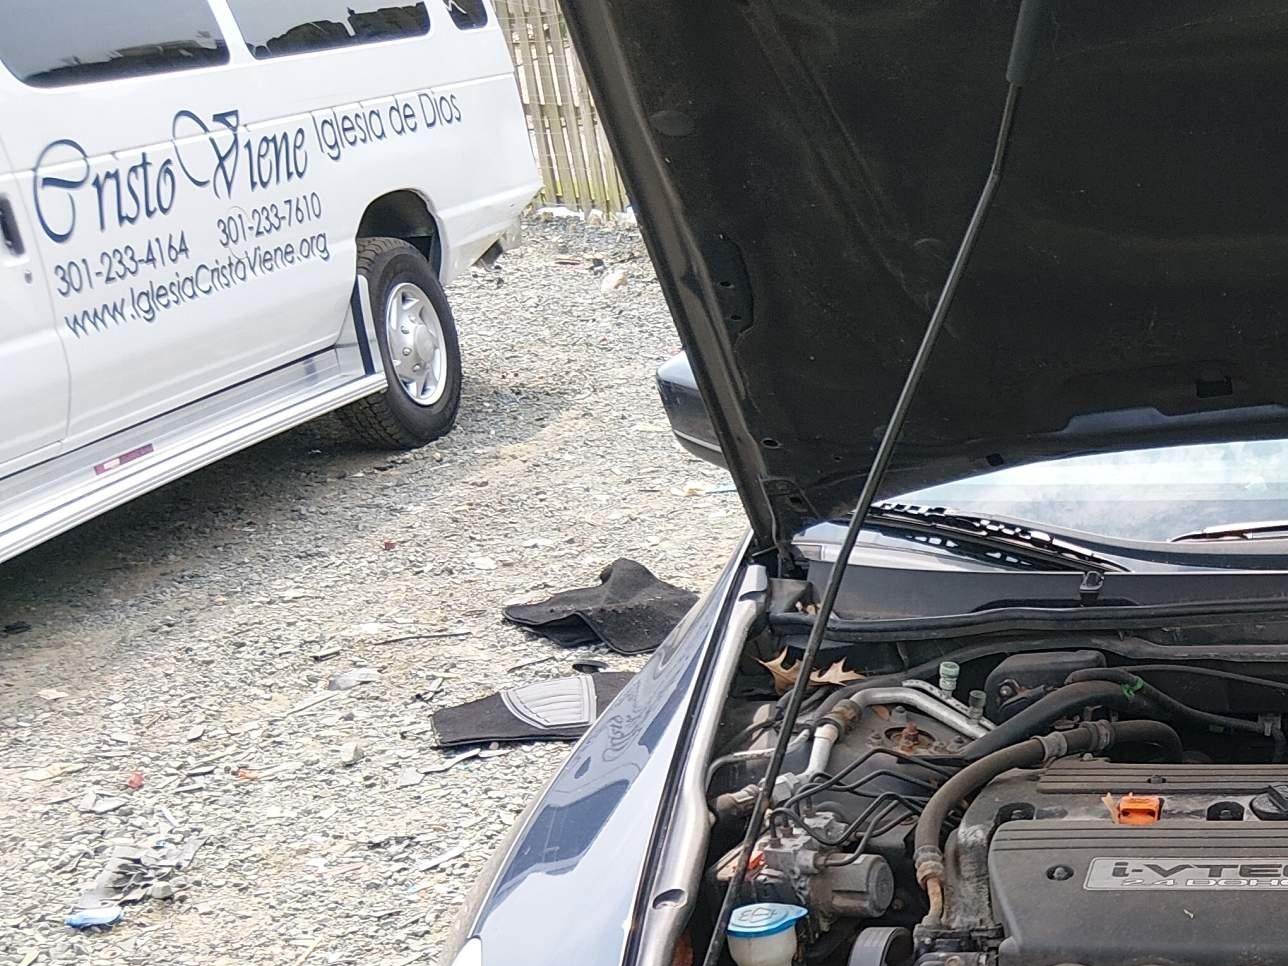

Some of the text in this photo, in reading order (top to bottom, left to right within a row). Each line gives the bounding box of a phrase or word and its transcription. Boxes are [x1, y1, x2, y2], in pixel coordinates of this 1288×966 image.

[312, 92, 462, 160] Iglesia de Dios
[33, 110, 307, 243] Cristo Viene
[217, 192, 321, 248] 301-233-7610
[54, 230, 190, 297] 301-233-4164
[64, 232, 331, 338] www.IglesiaCristoViene.org
